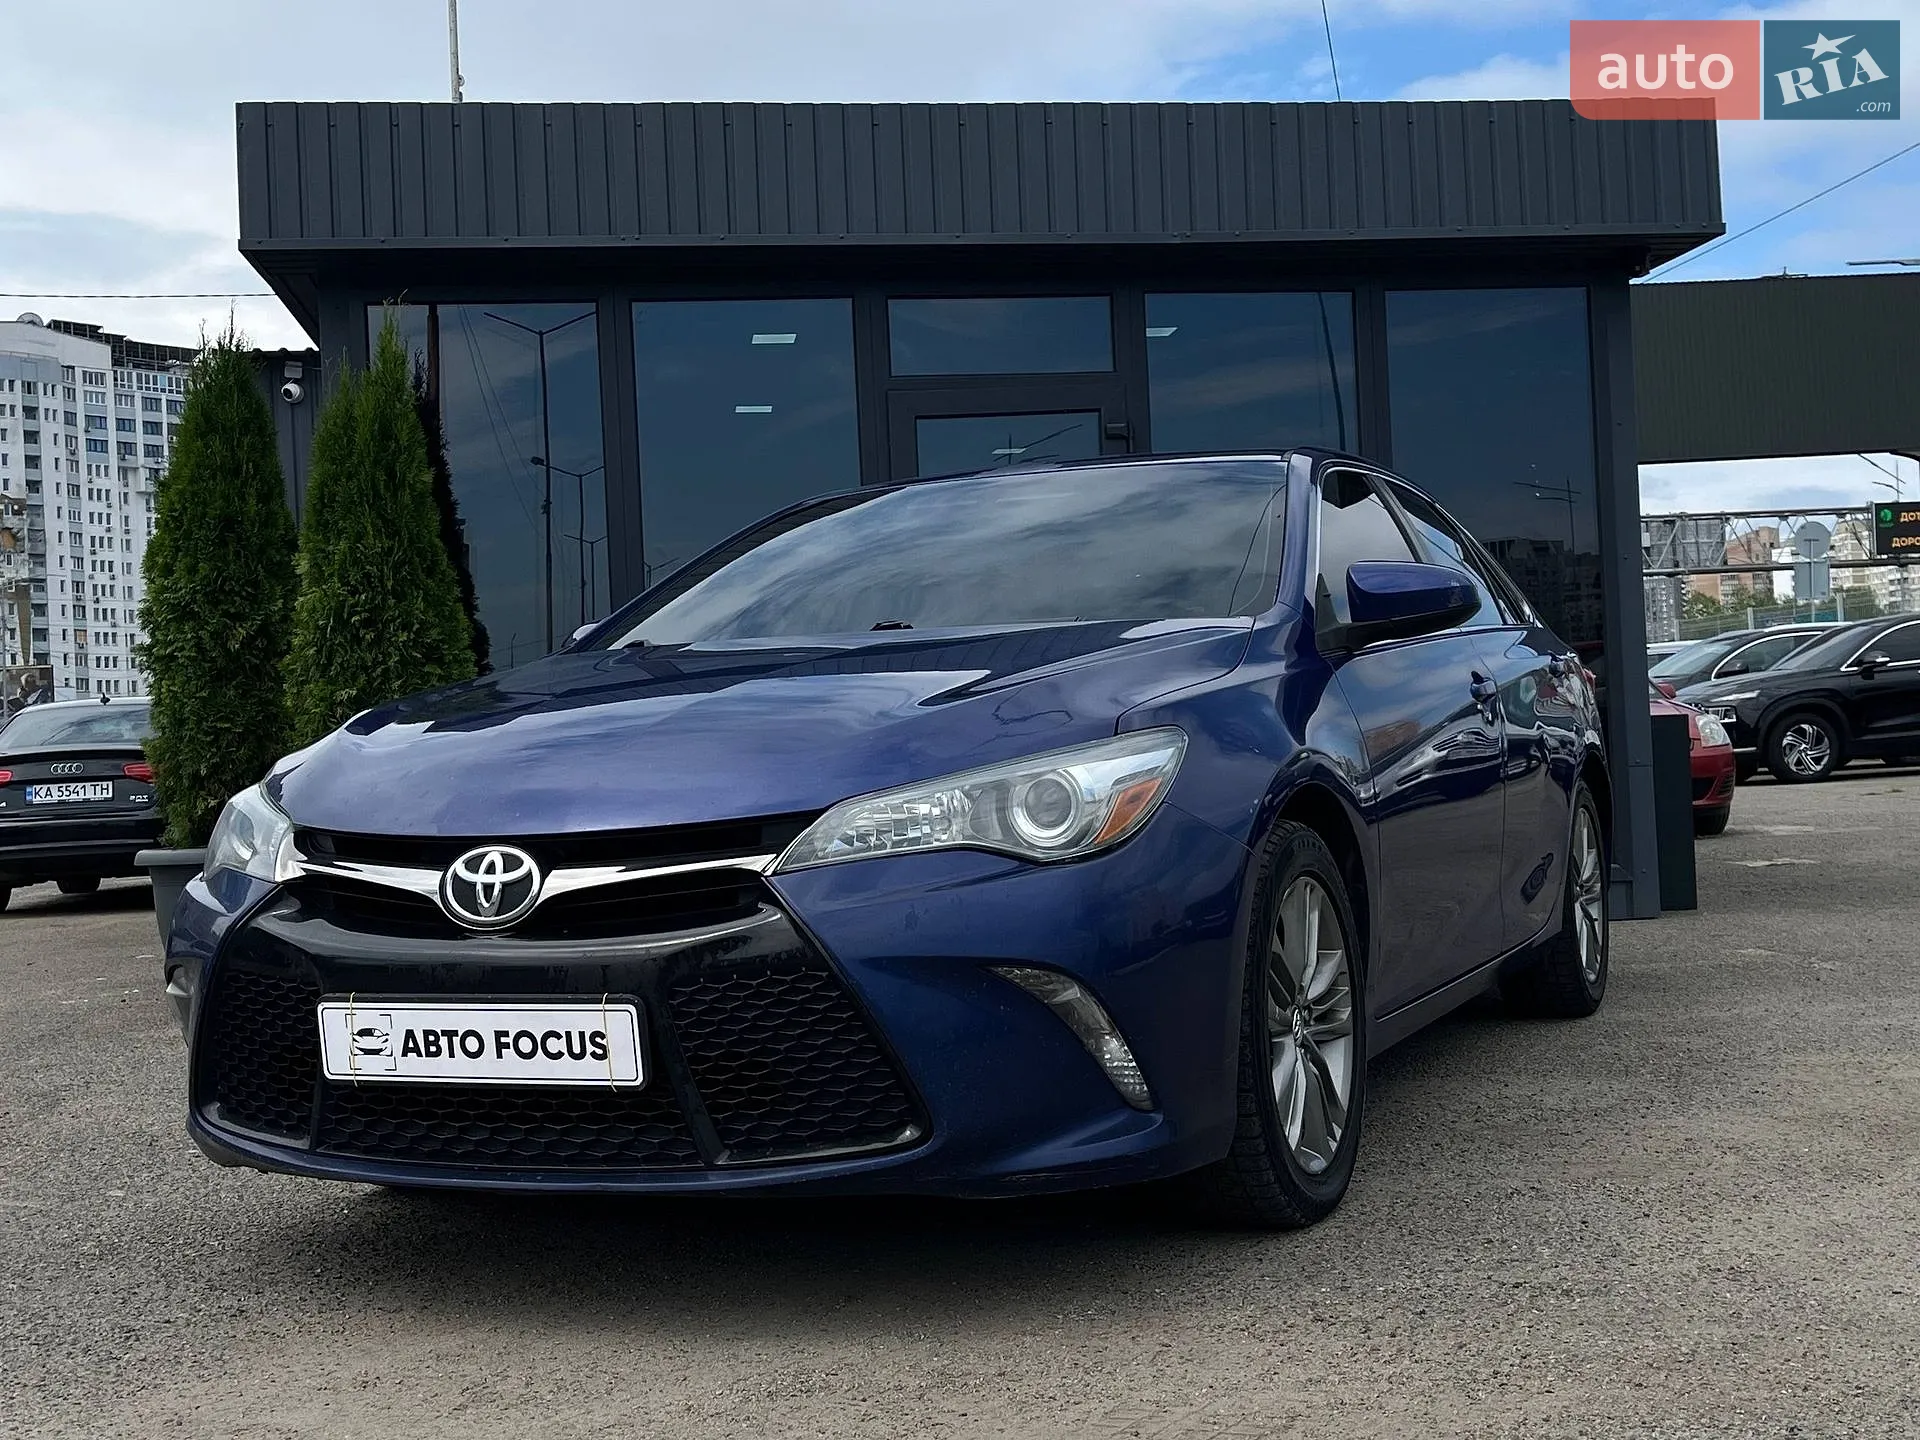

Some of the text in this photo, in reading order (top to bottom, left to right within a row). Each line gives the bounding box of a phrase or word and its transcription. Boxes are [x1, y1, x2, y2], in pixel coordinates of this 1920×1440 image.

[34, 783, 109, 799] KA 5541 TH
[400, 1029, 609, 1062] АВТО FOCUS
